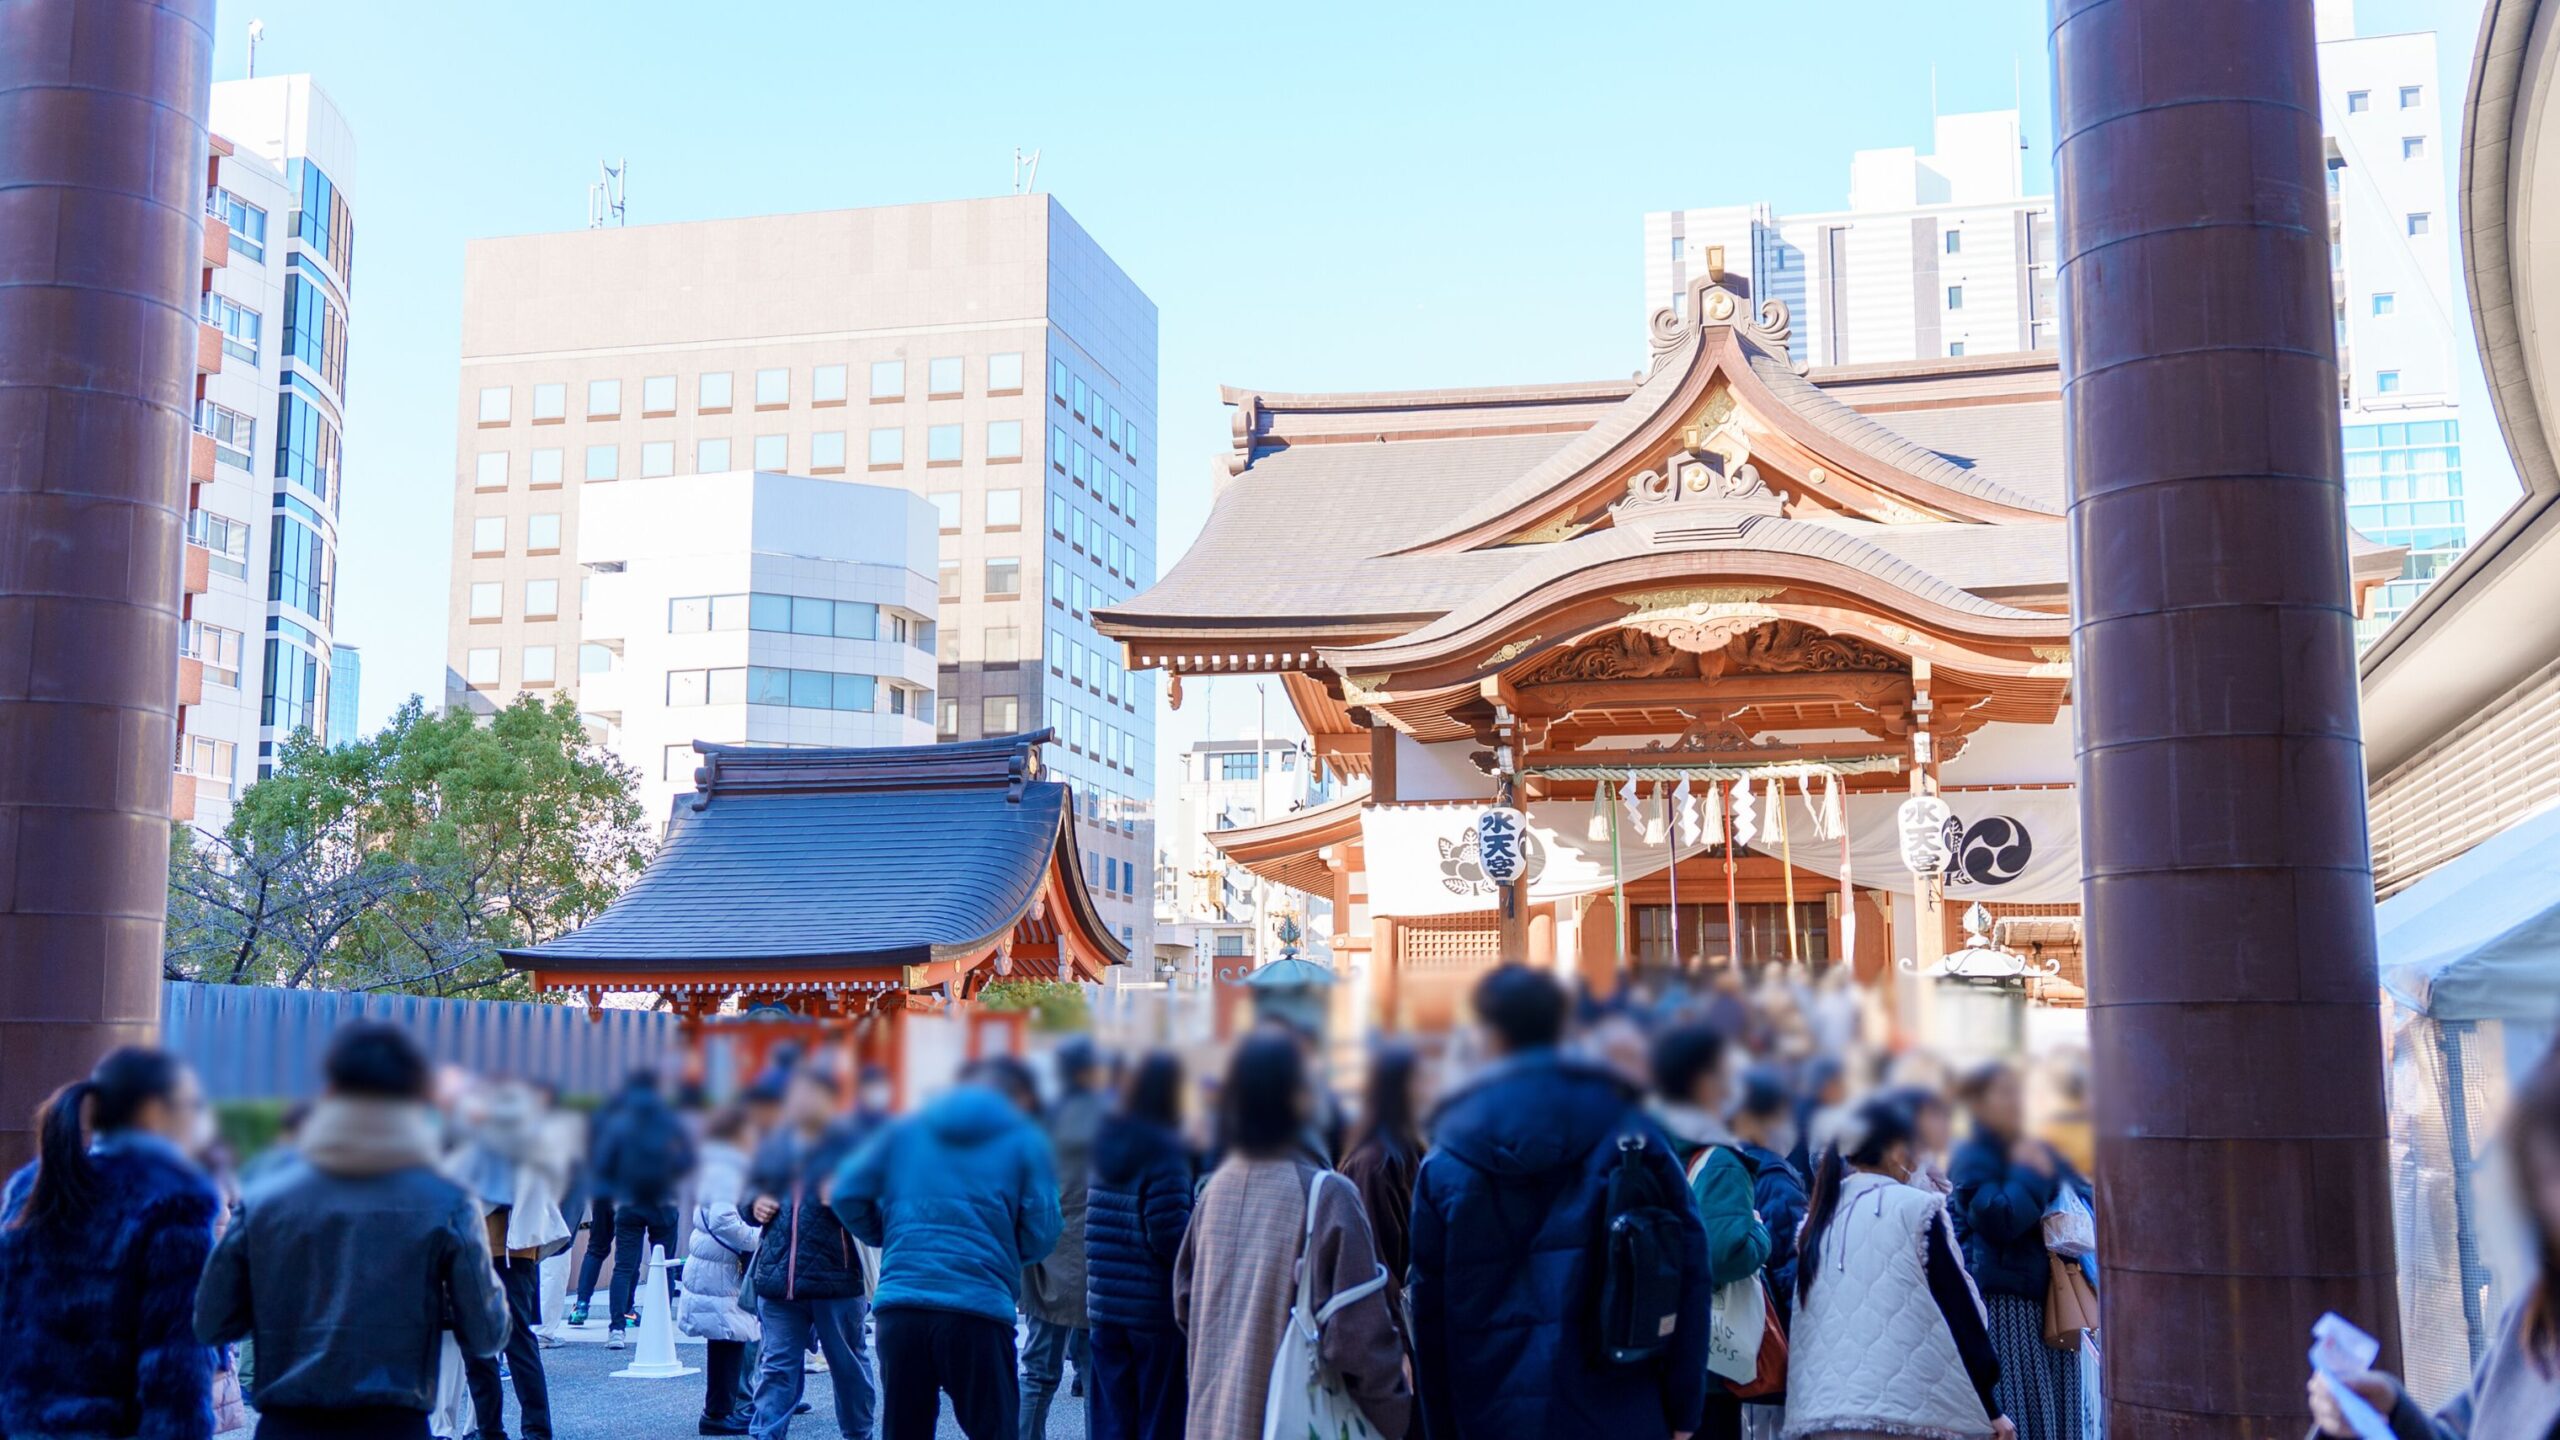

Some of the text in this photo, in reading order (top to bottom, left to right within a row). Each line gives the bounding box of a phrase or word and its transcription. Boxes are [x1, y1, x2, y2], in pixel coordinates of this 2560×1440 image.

[1482, 811, 1516, 878] 水天宮
[1904, 801, 1941, 872] 水天宮
